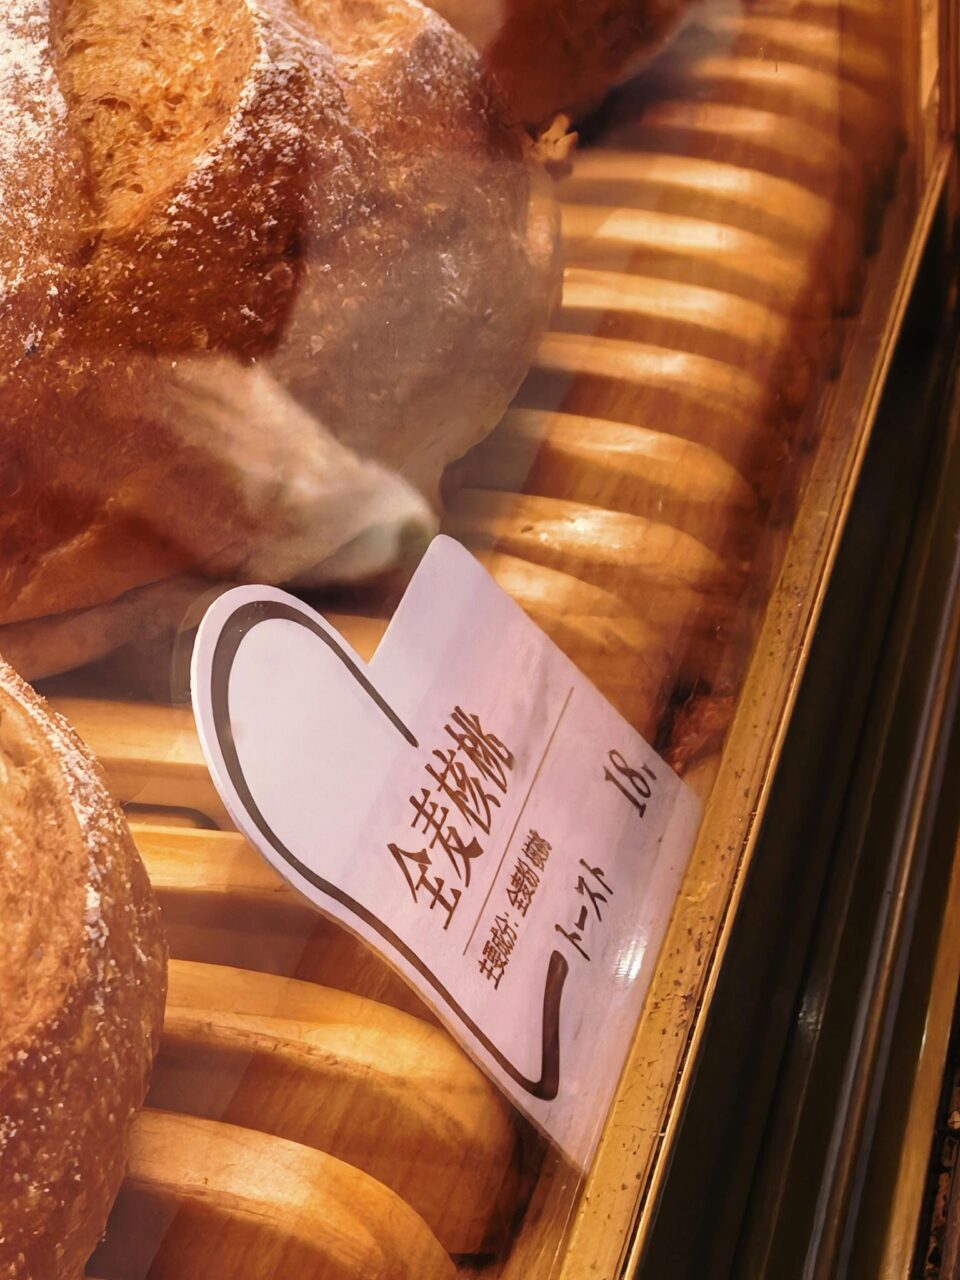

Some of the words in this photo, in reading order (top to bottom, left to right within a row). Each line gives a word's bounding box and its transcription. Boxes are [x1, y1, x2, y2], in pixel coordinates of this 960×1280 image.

[387, 705, 515, 930] 全麦核桃
[554, 858, 613, 961] トースト
